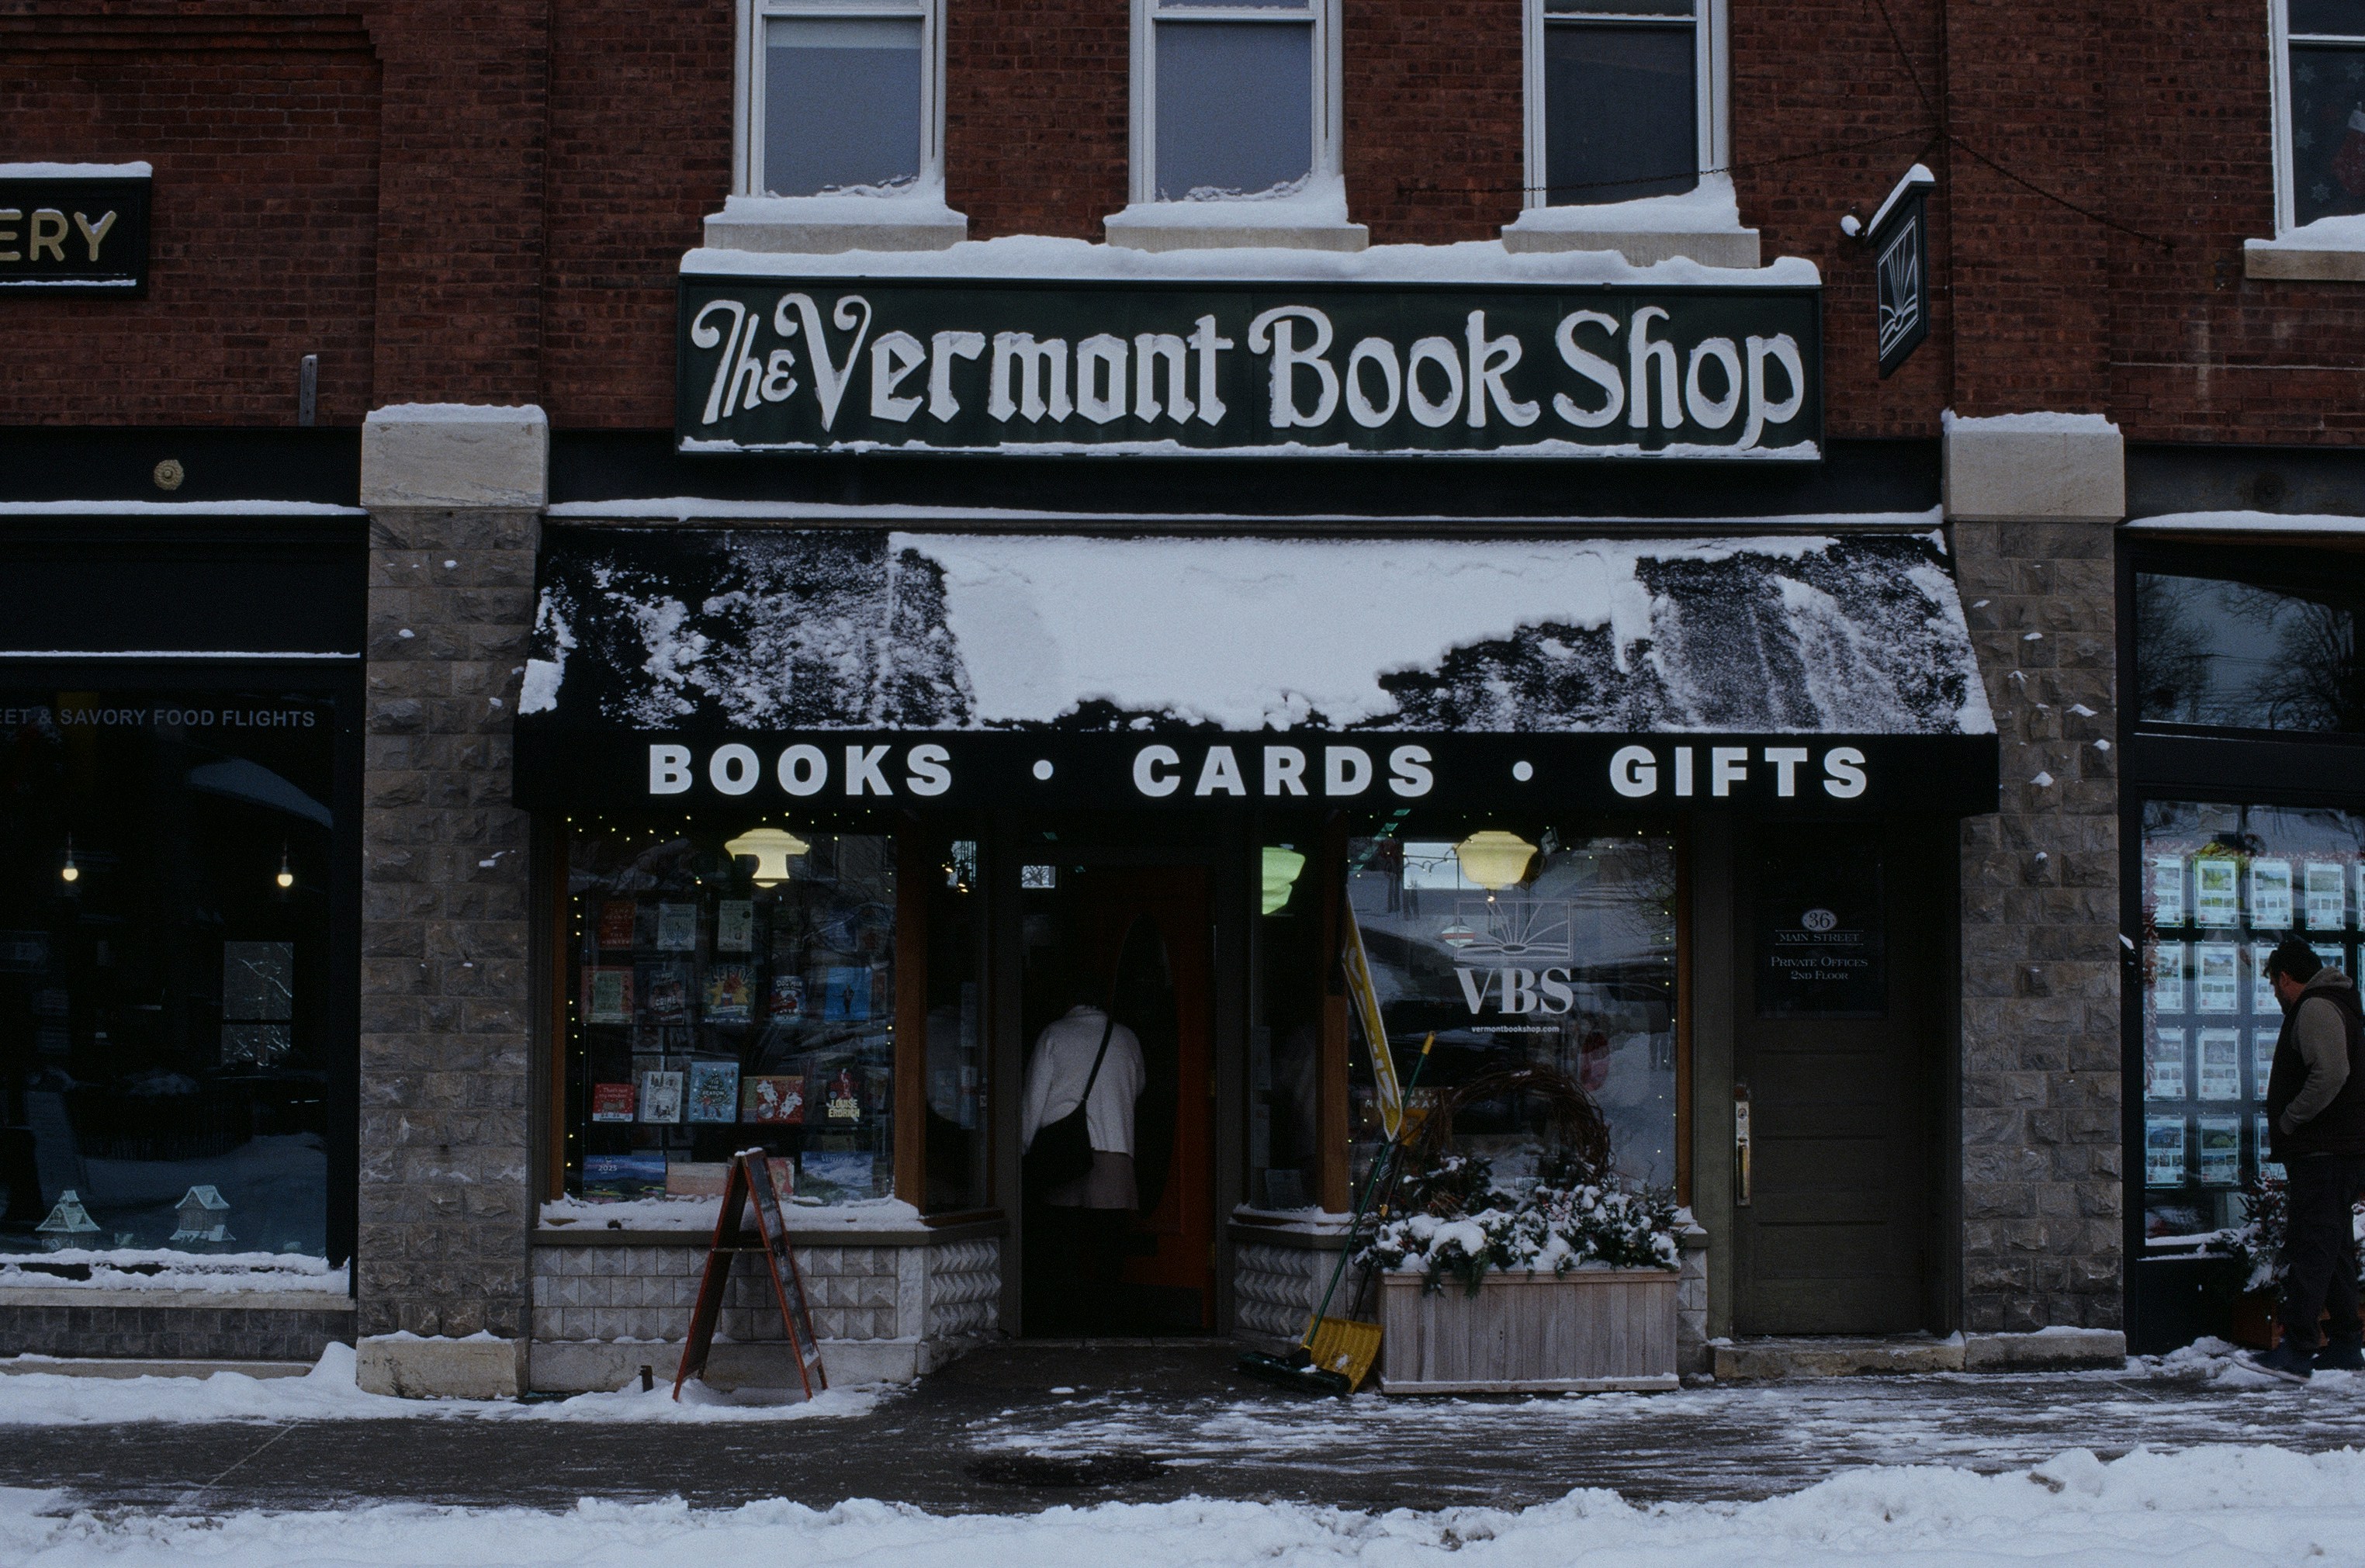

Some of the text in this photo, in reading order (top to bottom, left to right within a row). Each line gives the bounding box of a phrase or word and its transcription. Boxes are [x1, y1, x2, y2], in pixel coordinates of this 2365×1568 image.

[0, 208, 117, 261] ERY
[774, 292, 1234, 433] Vermont
[1248, 305, 1541, 428] Book
[1553, 306, 1805, 450] Shop
[0, 708, 315, 727] ET & SAVORY FOOD FLIGHTS
[649, 743, 1867, 798] BOOKS CARDS GIFTS
[1809, 912, 1830, 929] 36
[1780, 933, 1859, 942] MAIN STREET
[1771, 956, 1868, 967] PRIVATE OFFICES
[1815, 971, 1849, 980] FLOOR
[1453, 967, 1574, 1016] VBS
[1471, 1025, 1560, 1033] vermontbookshop.com
[831, 1098, 858, 1108] LOUISE
[828, 1108, 860, 1118] ERDRICH
